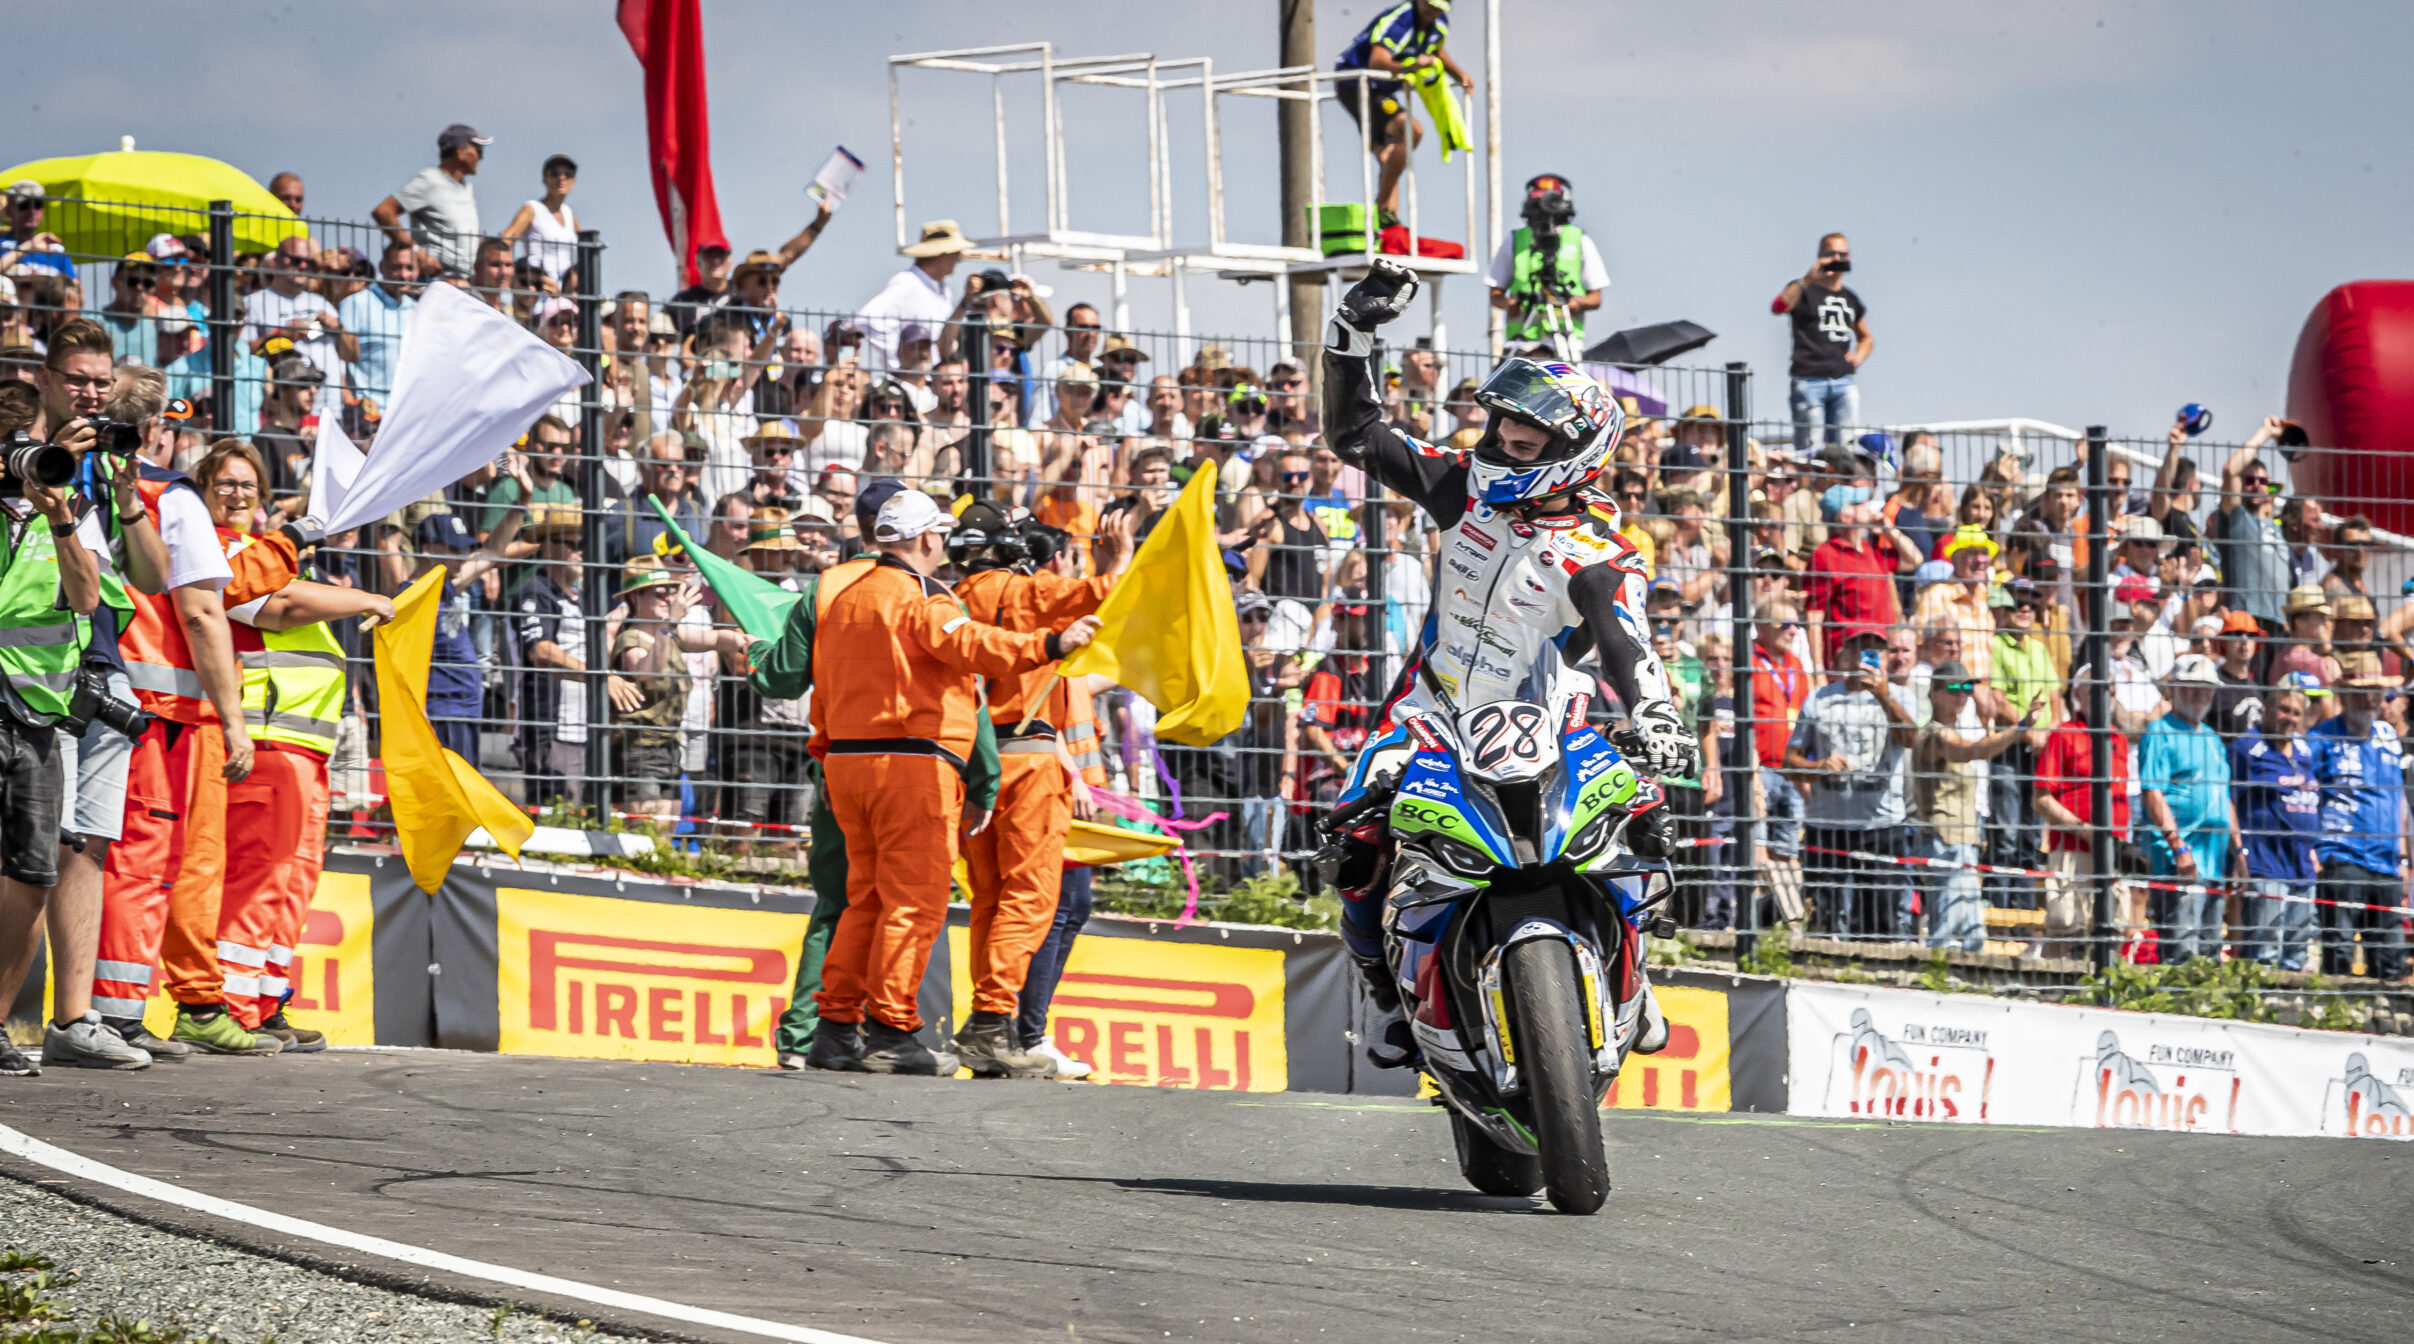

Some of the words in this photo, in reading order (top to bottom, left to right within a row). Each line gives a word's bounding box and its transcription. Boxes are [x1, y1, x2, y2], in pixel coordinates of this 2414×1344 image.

[1469, 705, 1546, 770] 28
[1580, 772, 1627, 812] BCC
[1398, 803, 1460, 829] BCC
[529, 929, 787, 1048] PIRELLI
[1051, 972, 1255, 1091] PRELLI
[1904, 1023, 1926, 1041] FUN
[1931, 1026, 1989, 1046] COMPANY
[2150, 1044, 2173, 1062] FUN
[2176, 1046, 2235, 1067] COMPANY
